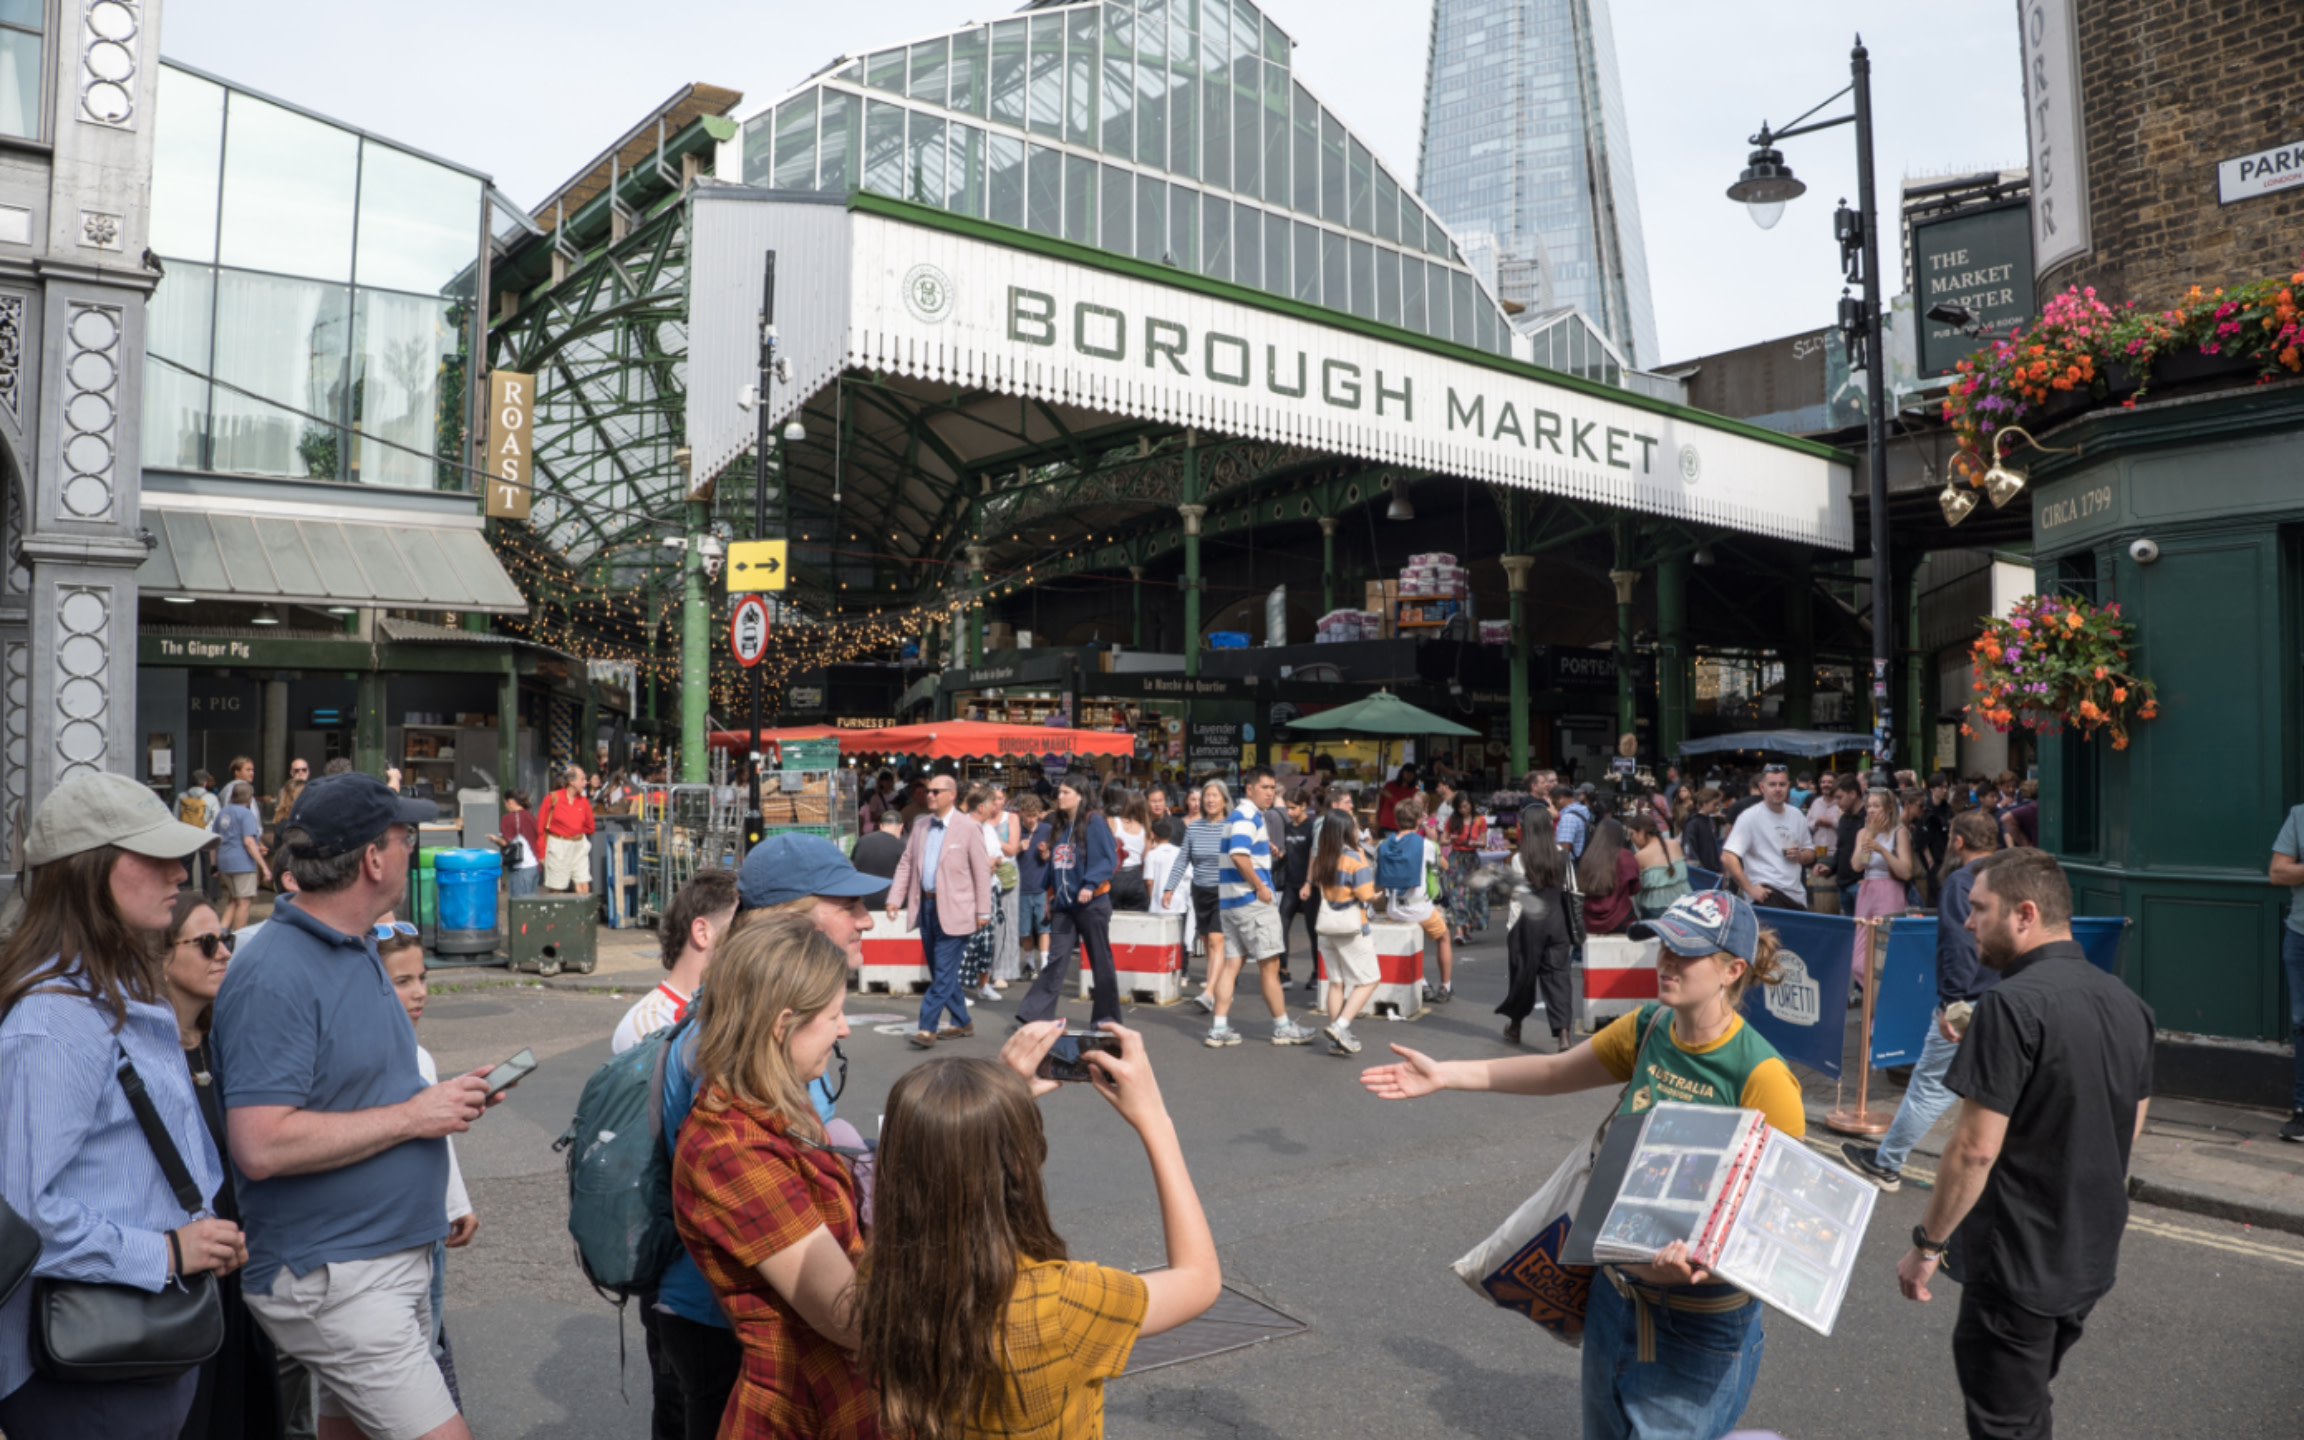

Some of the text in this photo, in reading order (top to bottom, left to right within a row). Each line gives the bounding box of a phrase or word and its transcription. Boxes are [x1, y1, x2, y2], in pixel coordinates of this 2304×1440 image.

[2025, 0, 2058, 243] ORTER
[2263, 172, 2302, 188] LONDON
[1929, 248, 1970, 270] THE
[1931, 263, 2013, 294] MARKET
[1933, 329, 1951, 338] PUB
[1996, 316, 2024, 327] ROOM
[1006, 284, 1414, 423] BOROUGH
[1447, 387, 1659, 475] MARKET
[499, 381, 523, 510] ROAST
[2041, 485, 2111, 530] CIRCA 1799
[160, 640, 250, 659] The Ginger Pig
[1144, 678, 1153, 690] Le
[209, 697, 241, 711] PIG
[836, 716, 884, 729] FURNESS
[1192, 722, 1237, 735] Lavender
[998, 735, 1077, 753] BOROUGH MARKET
[1190, 744, 1239, 756] Lemonade
[1204, 735, 1230, 745] Haze
[1646, 1063, 1714, 1099] AUSTRALIA
[1531, 1252, 1578, 1293] TOUR
